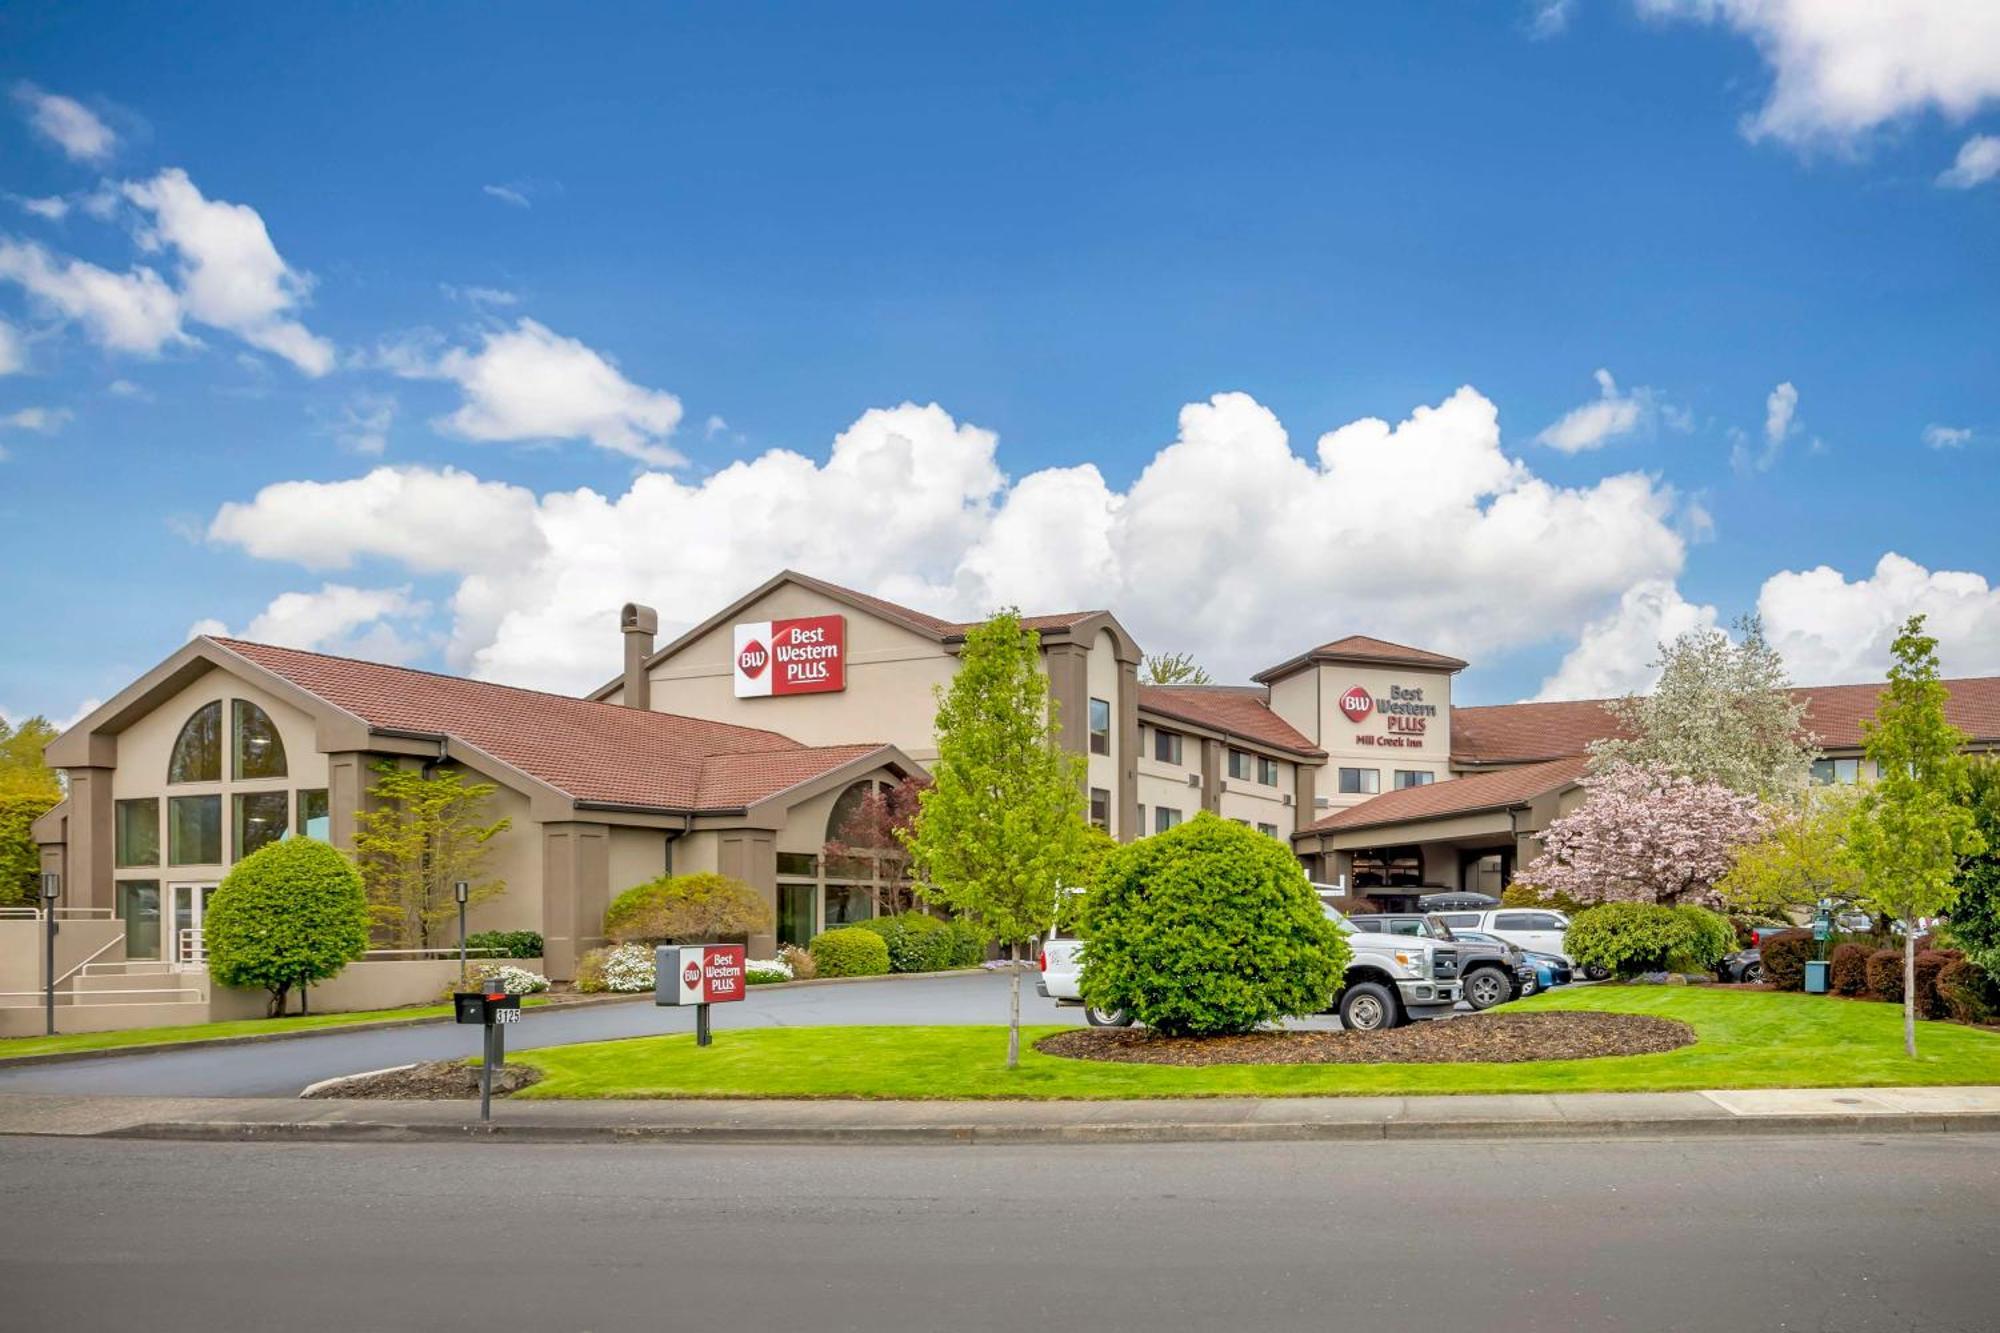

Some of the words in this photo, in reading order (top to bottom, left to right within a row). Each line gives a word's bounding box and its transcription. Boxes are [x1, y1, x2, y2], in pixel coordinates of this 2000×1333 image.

[791, 627, 824, 644] Best
[742, 651, 765, 668] BW
[777, 645, 838, 662] Western
[1391, 685, 1423, 701] Best
[1345, 697, 1370, 711] BW
[1376, 699, 1436, 717] Western
[1388, 716, 1426, 732] PLUS
[1356, 735, 1375, 747] Mill
[1377, 736, 1405, 748] Creek
[1407, 737, 1423, 748] Inn
[714, 954, 733, 966] Best
[684, 970, 700, 982] BW
[706, 966, 740, 978] Western
[712, 978, 734, 991] PLUS
